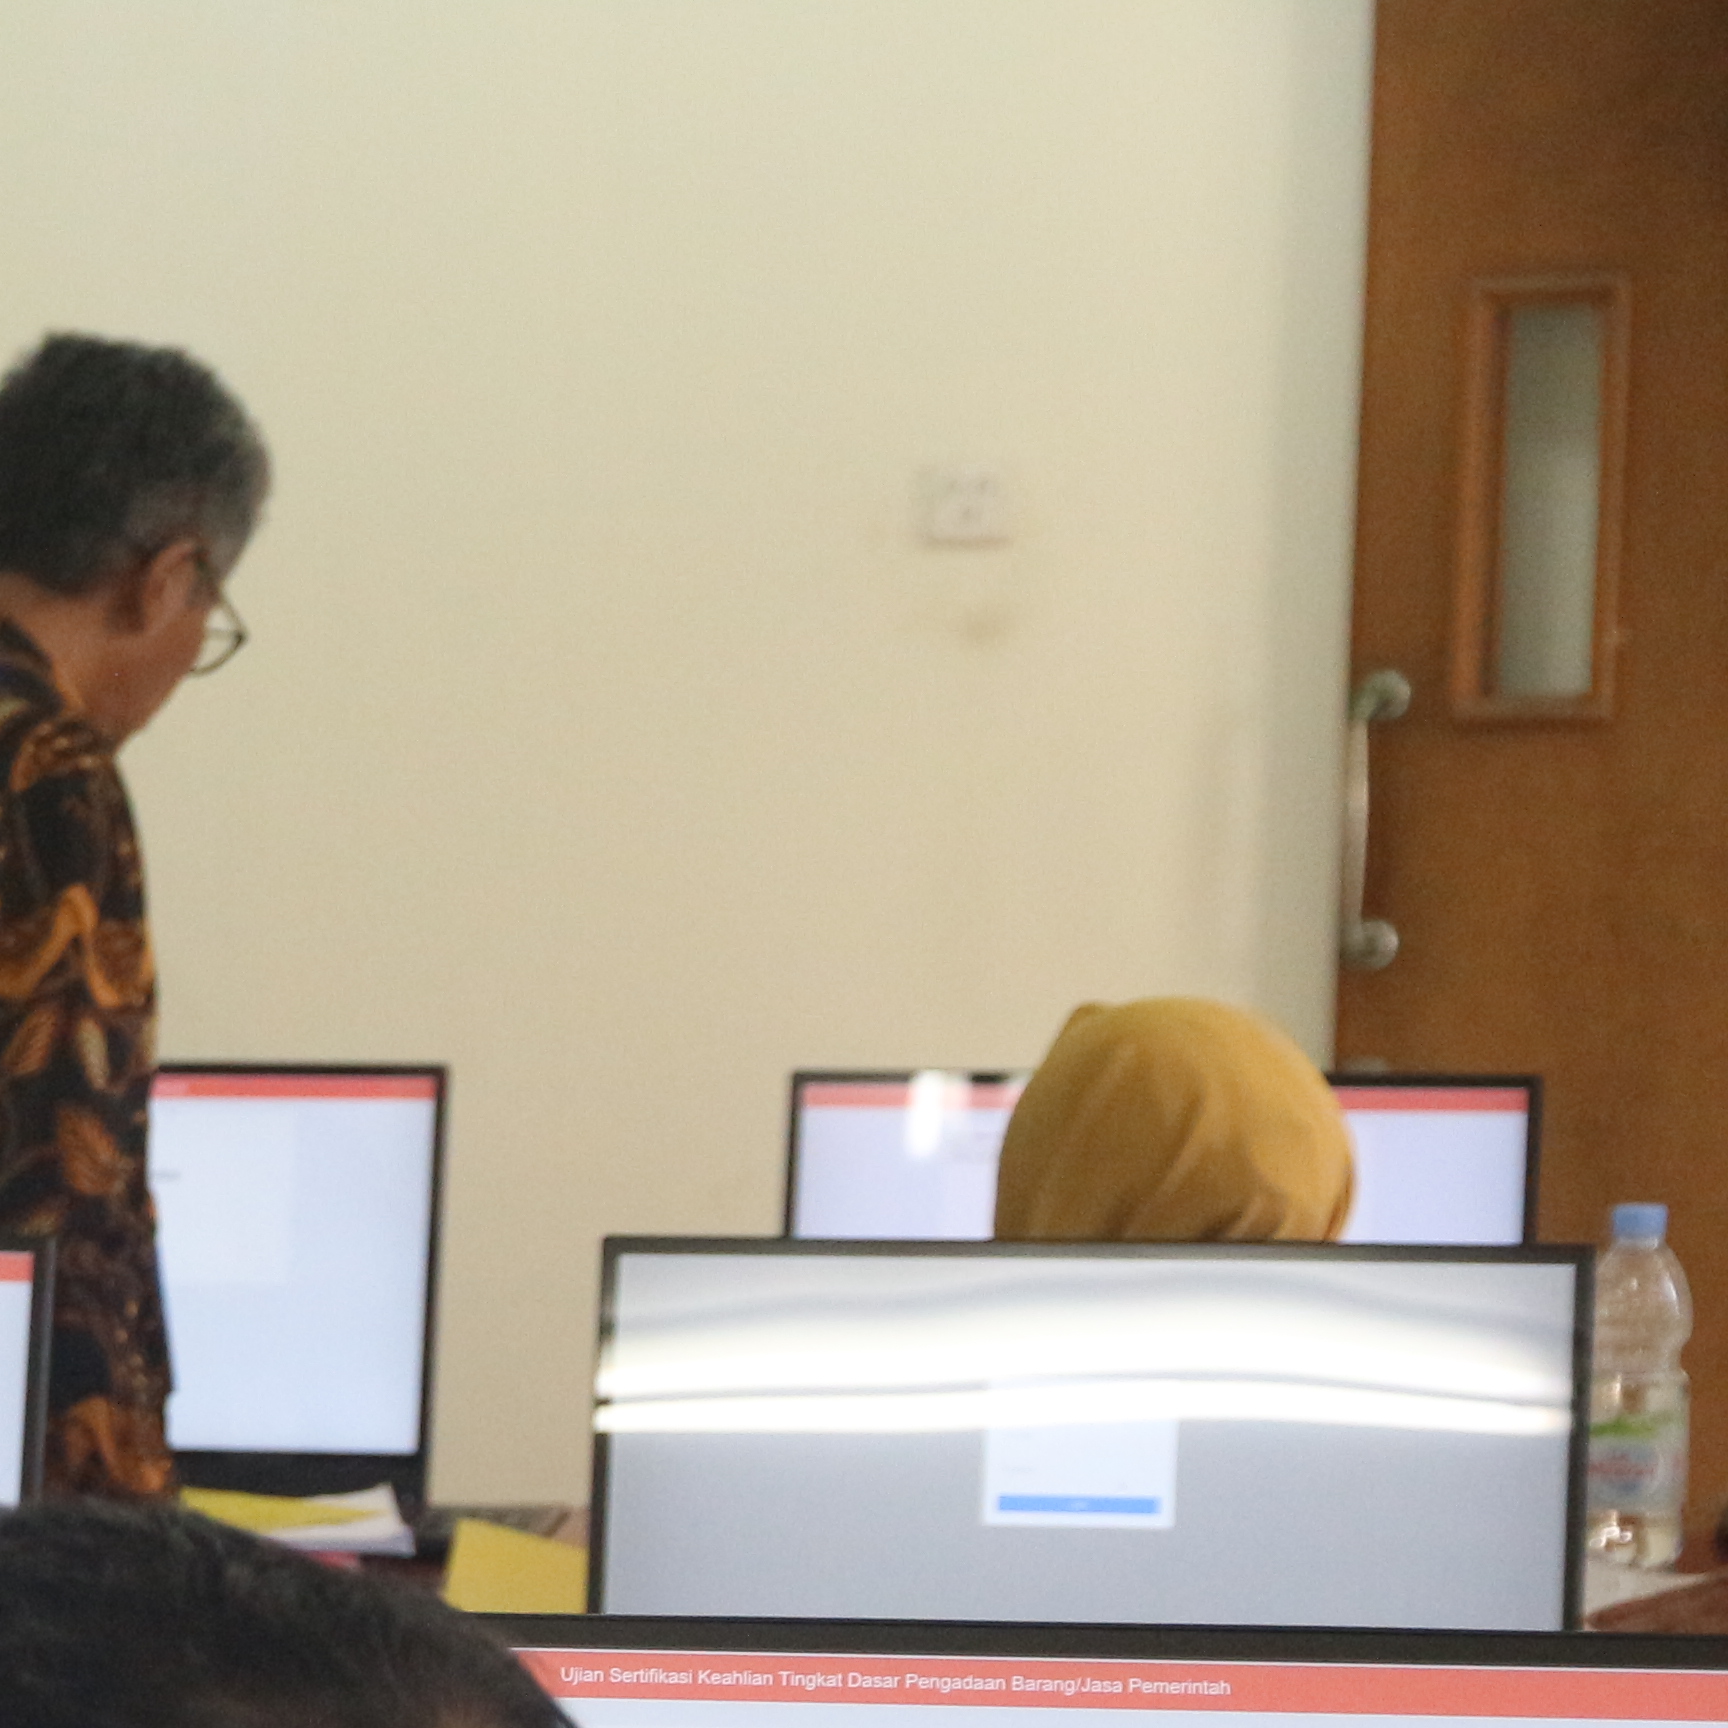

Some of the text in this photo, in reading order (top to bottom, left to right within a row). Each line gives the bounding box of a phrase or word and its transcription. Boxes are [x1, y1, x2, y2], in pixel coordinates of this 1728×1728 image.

[560, 1666, 1232, 1696] Ujian Sertifikasi Keahlian Tingkat Dasar Pengadaan Barang/Jasa Pemerintah
